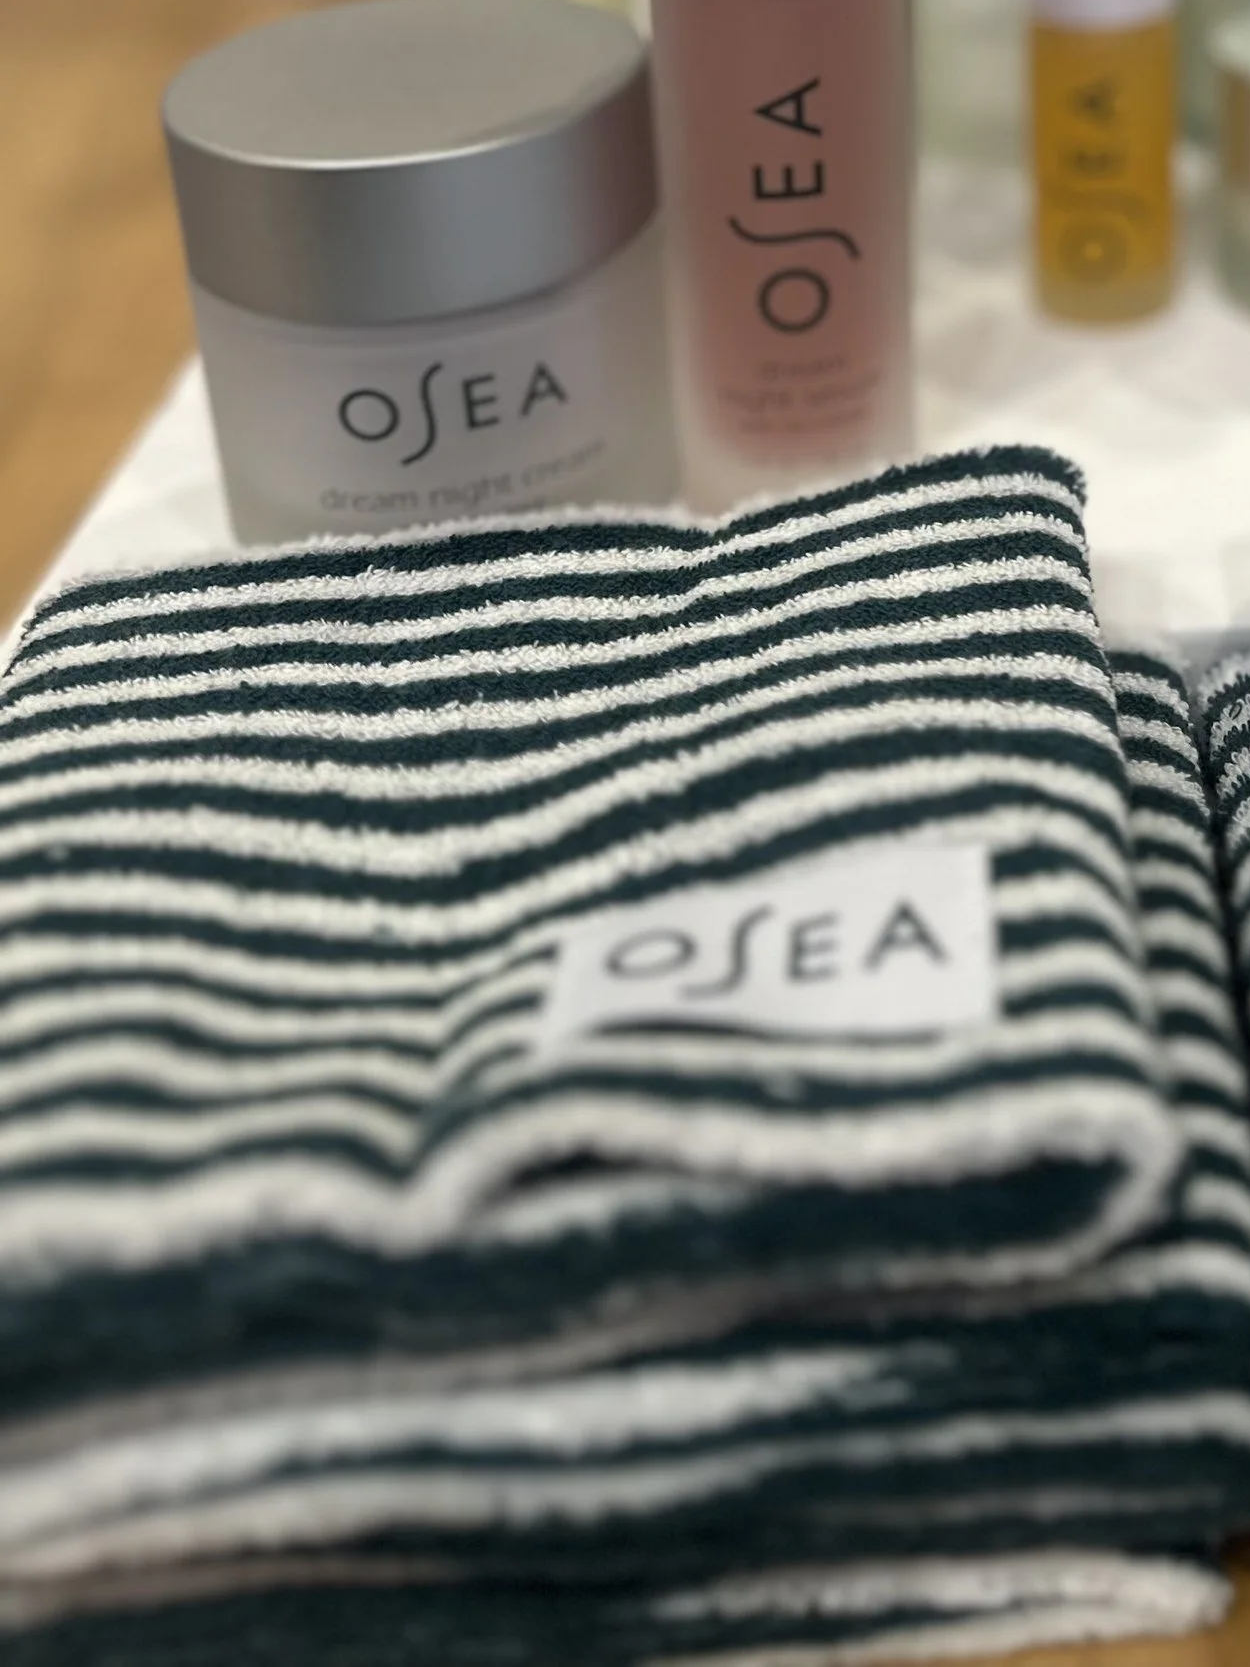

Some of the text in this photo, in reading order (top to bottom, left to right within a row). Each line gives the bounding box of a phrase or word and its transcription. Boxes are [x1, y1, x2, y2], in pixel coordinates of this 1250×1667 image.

[727, 75, 862, 335] OSEA
[338, 361, 570, 466] OSEA
[320, 486, 419, 514] dream
[428, 471, 514, 511] night
[605, 899, 952, 1001] OSEA
